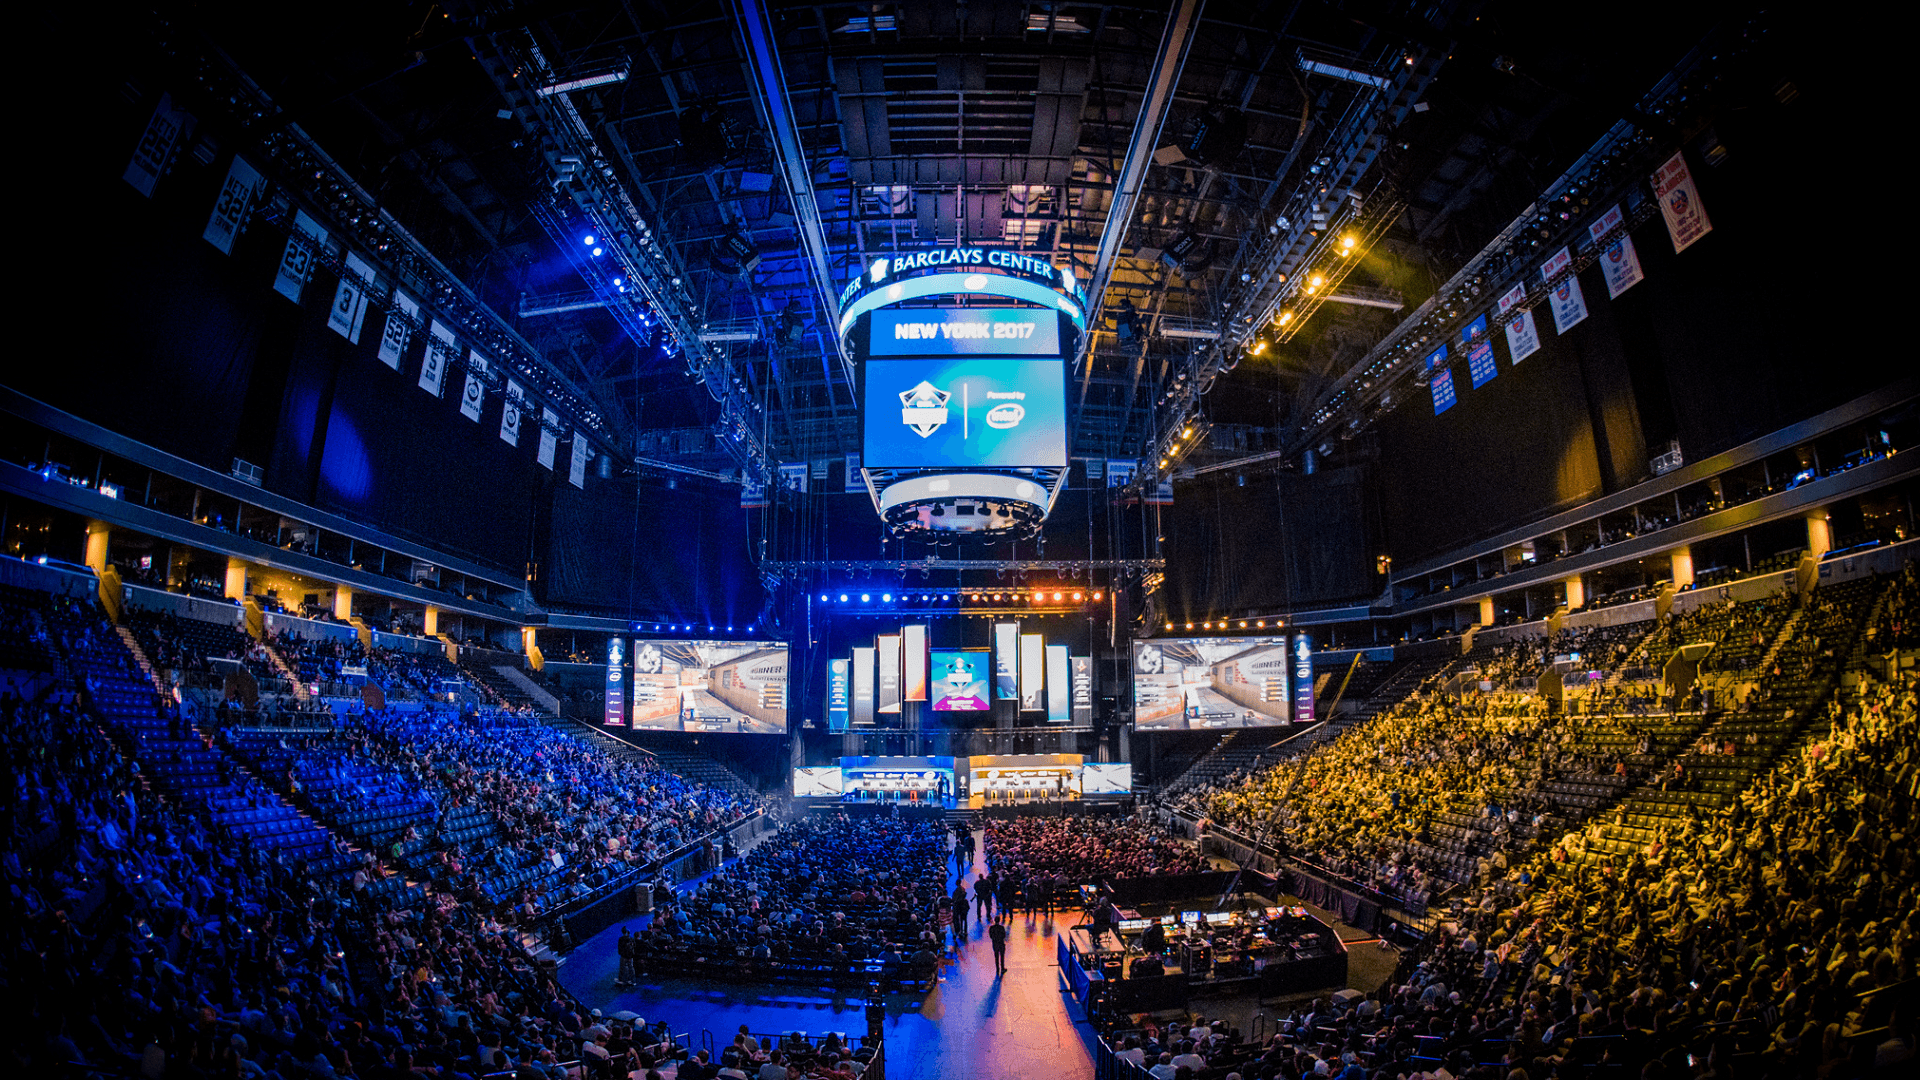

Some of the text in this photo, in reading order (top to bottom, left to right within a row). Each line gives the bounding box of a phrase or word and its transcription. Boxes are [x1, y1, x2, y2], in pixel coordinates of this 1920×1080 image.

[151, 112, 177, 141] NETS
[138, 127, 171, 166] 25
[227, 175, 249, 201] NETS
[217, 189, 244, 224] 32
[284, 242, 308, 275] 23
[893, 248, 1054, 280] BARCLAYS CENTER
[340, 289, 352, 313] 3
[386, 318, 404, 343] 52
[895, 322, 1036, 340] NEW YORK 2017
[429, 351, 439, 370] 5
[987, 391, 1026, 400] Powered by
